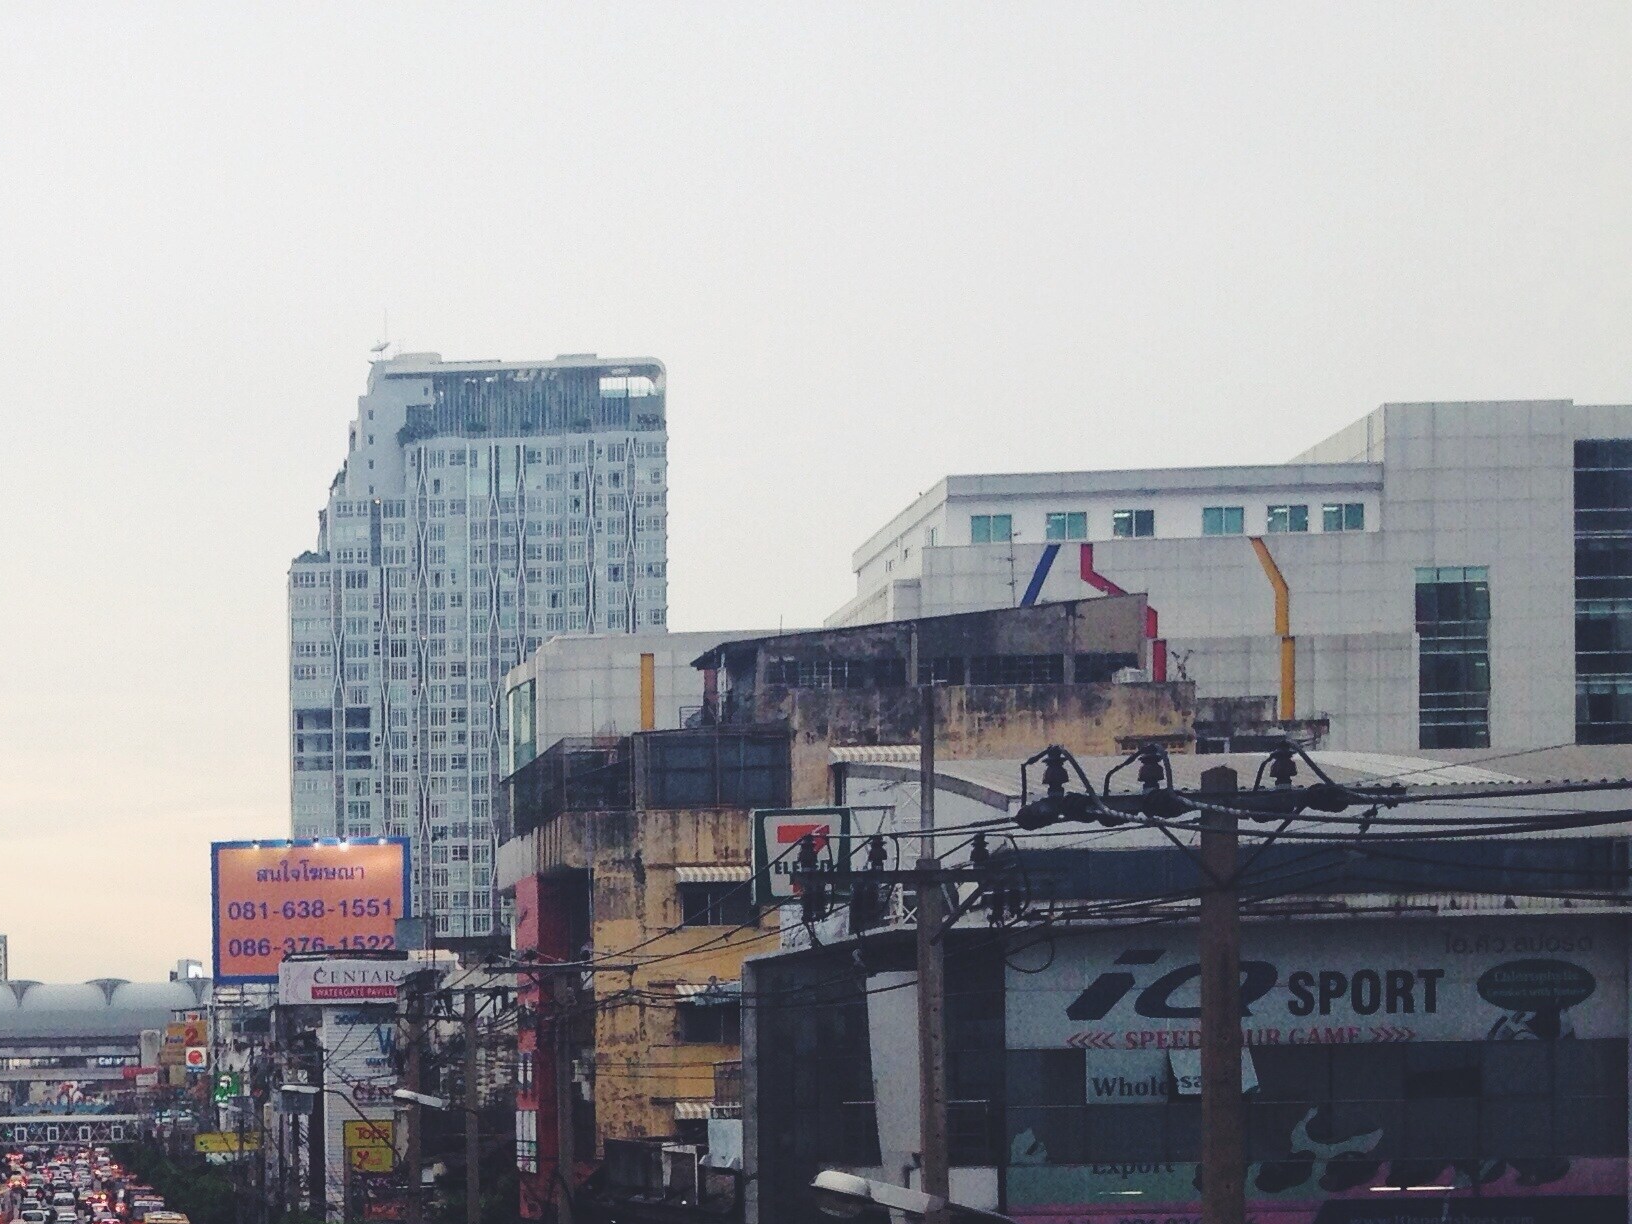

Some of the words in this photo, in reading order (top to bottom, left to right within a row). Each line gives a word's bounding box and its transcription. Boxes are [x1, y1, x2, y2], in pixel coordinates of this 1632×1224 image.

[257, 860, 365, 882] สนใจโฆษณา
[228, 898, 392, 920] 081-638-1551
[228, 935, 395, 957] 086-376-1522
[1288, 968, 1444, 1016] SPORT
[1125, 1030, 1201, 1049] SPEED
[1288, 1026, 1361, 1046] GAME
